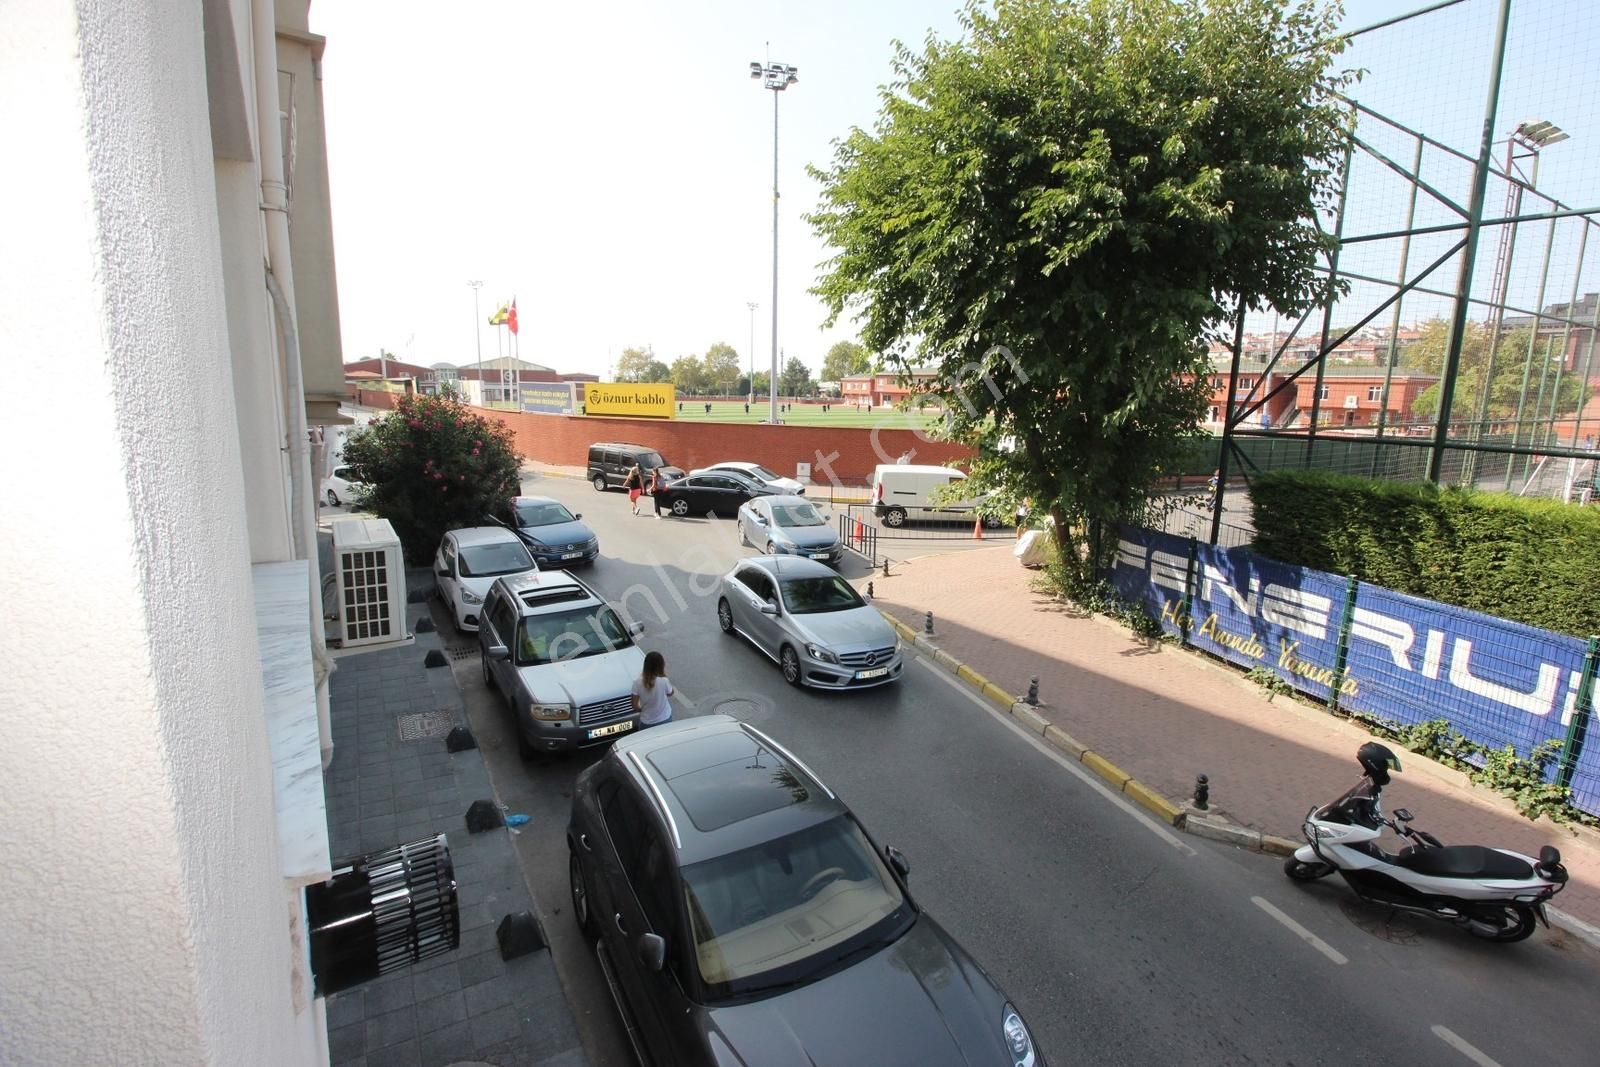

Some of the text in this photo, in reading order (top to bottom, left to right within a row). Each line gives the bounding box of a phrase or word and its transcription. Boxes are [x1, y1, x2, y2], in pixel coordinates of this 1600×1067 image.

[603, 392, 666, 406] öznur kablo
[1111, 539, 1600, 727] FENERIU
